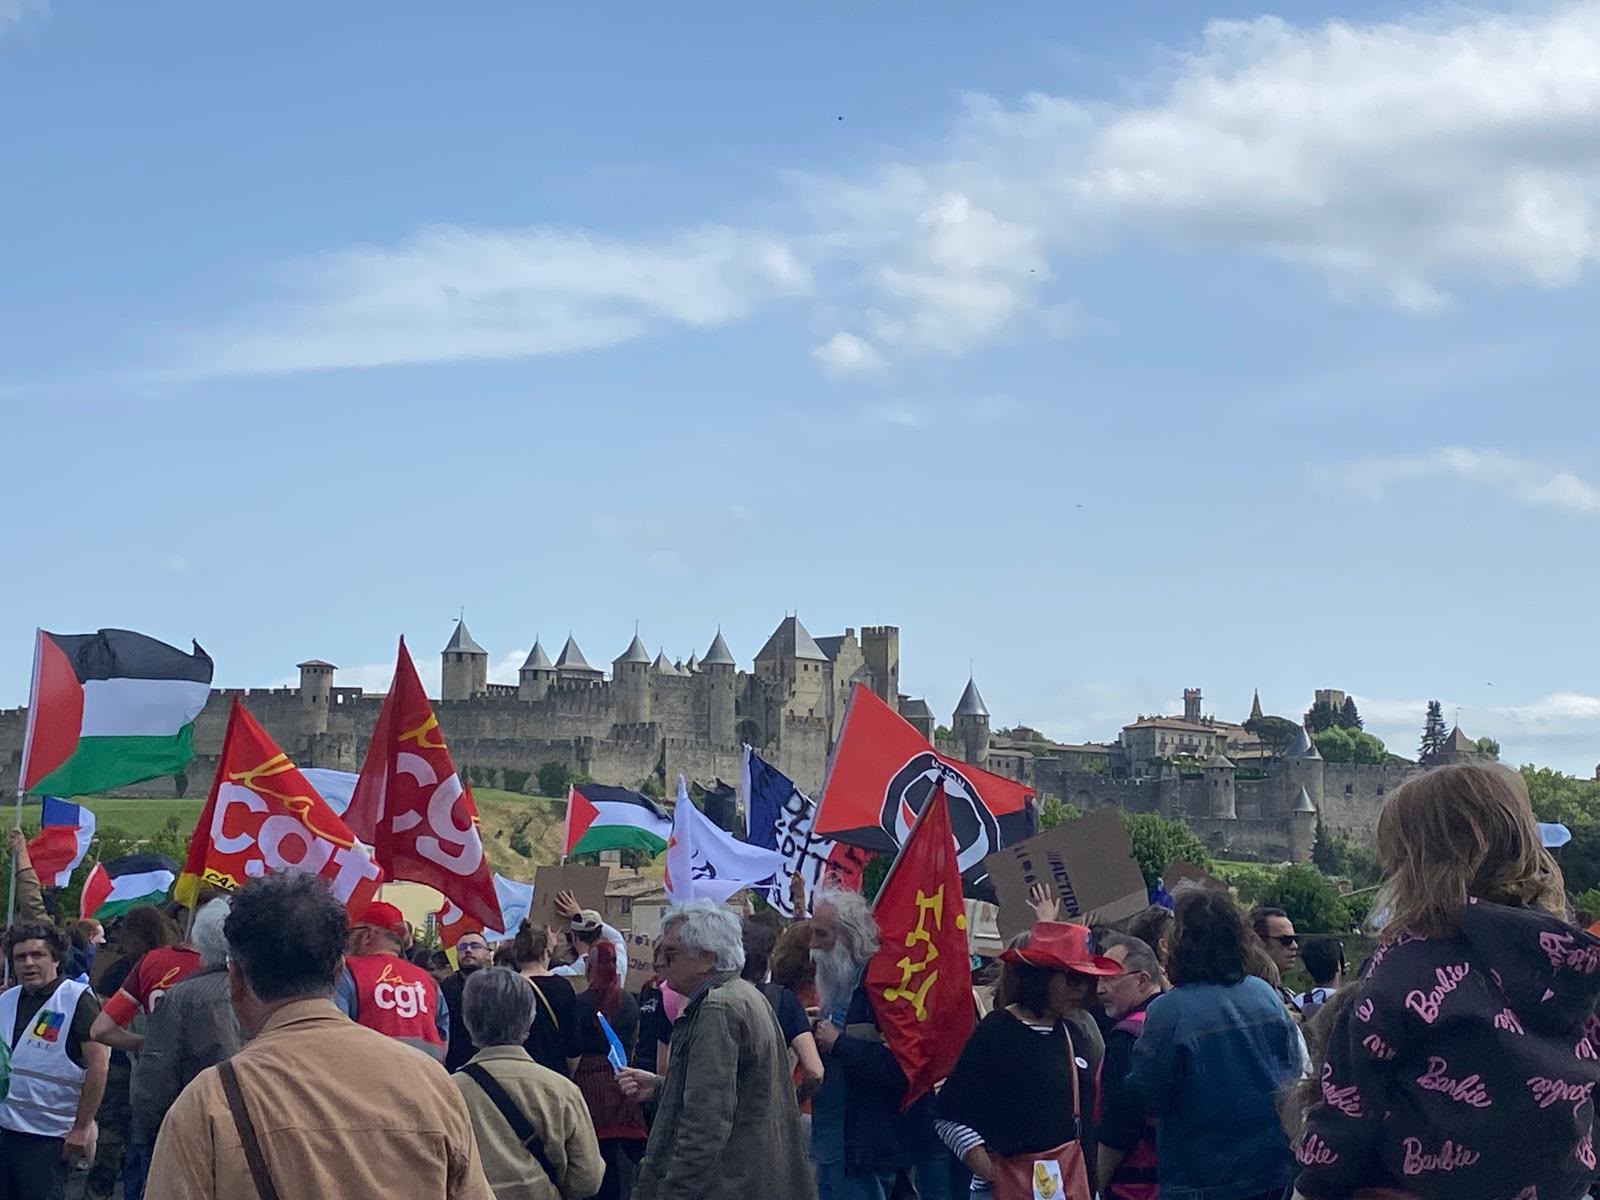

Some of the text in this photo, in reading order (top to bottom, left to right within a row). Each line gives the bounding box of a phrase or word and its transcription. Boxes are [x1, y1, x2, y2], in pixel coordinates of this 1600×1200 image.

[374, 980, 429, 1019] cgt
[1405, 961, 1470, 1025] Barbie
[1416, 1056, 1493, 1108] Barbie
[1402, 1136, 1481, 1176] Barbie
